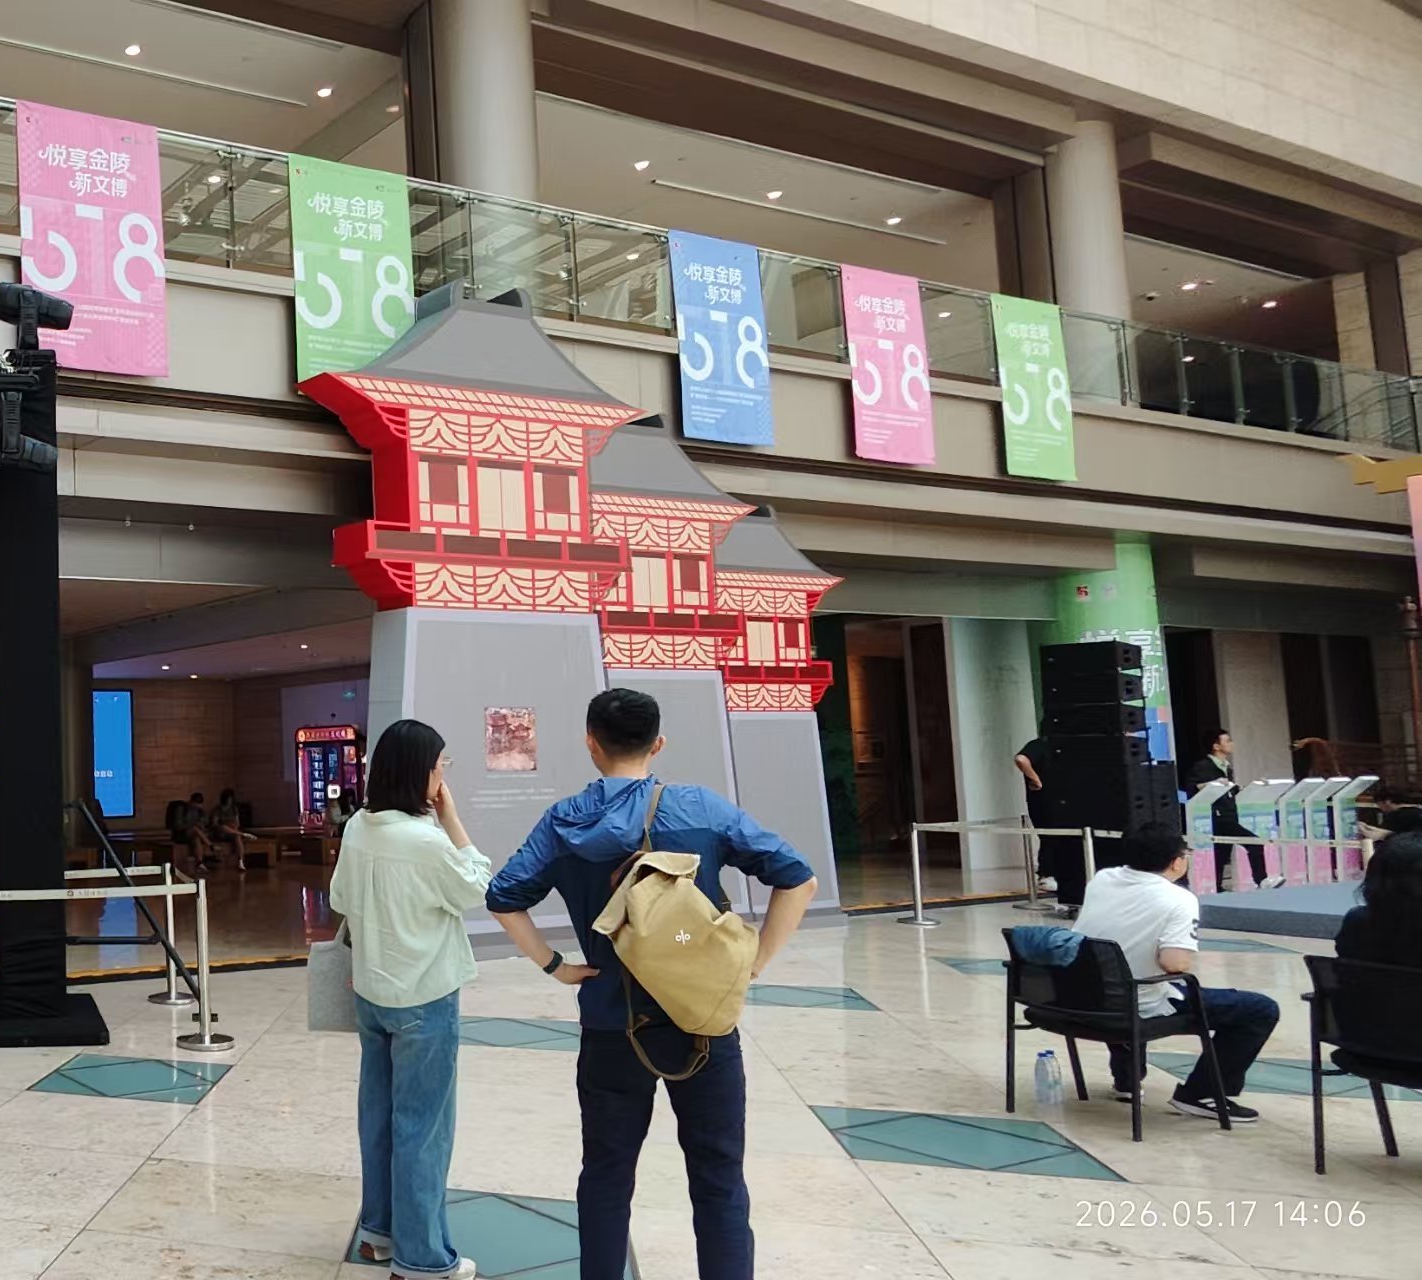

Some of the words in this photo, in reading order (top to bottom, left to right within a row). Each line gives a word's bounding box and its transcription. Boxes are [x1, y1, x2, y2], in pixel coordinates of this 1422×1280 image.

[39, 144, 136, 181] 悦享金陵
[70, 171, 128, 197] 新文博
[307, 192, 388, 226] 悦享金陵
[334, 218, 383, 241] 新文博
[683, 262, 746, 292] 悦享金陵
[705, 285, 742, 304] 新文博
[855, 295, 910, 320] 悦享金陵
